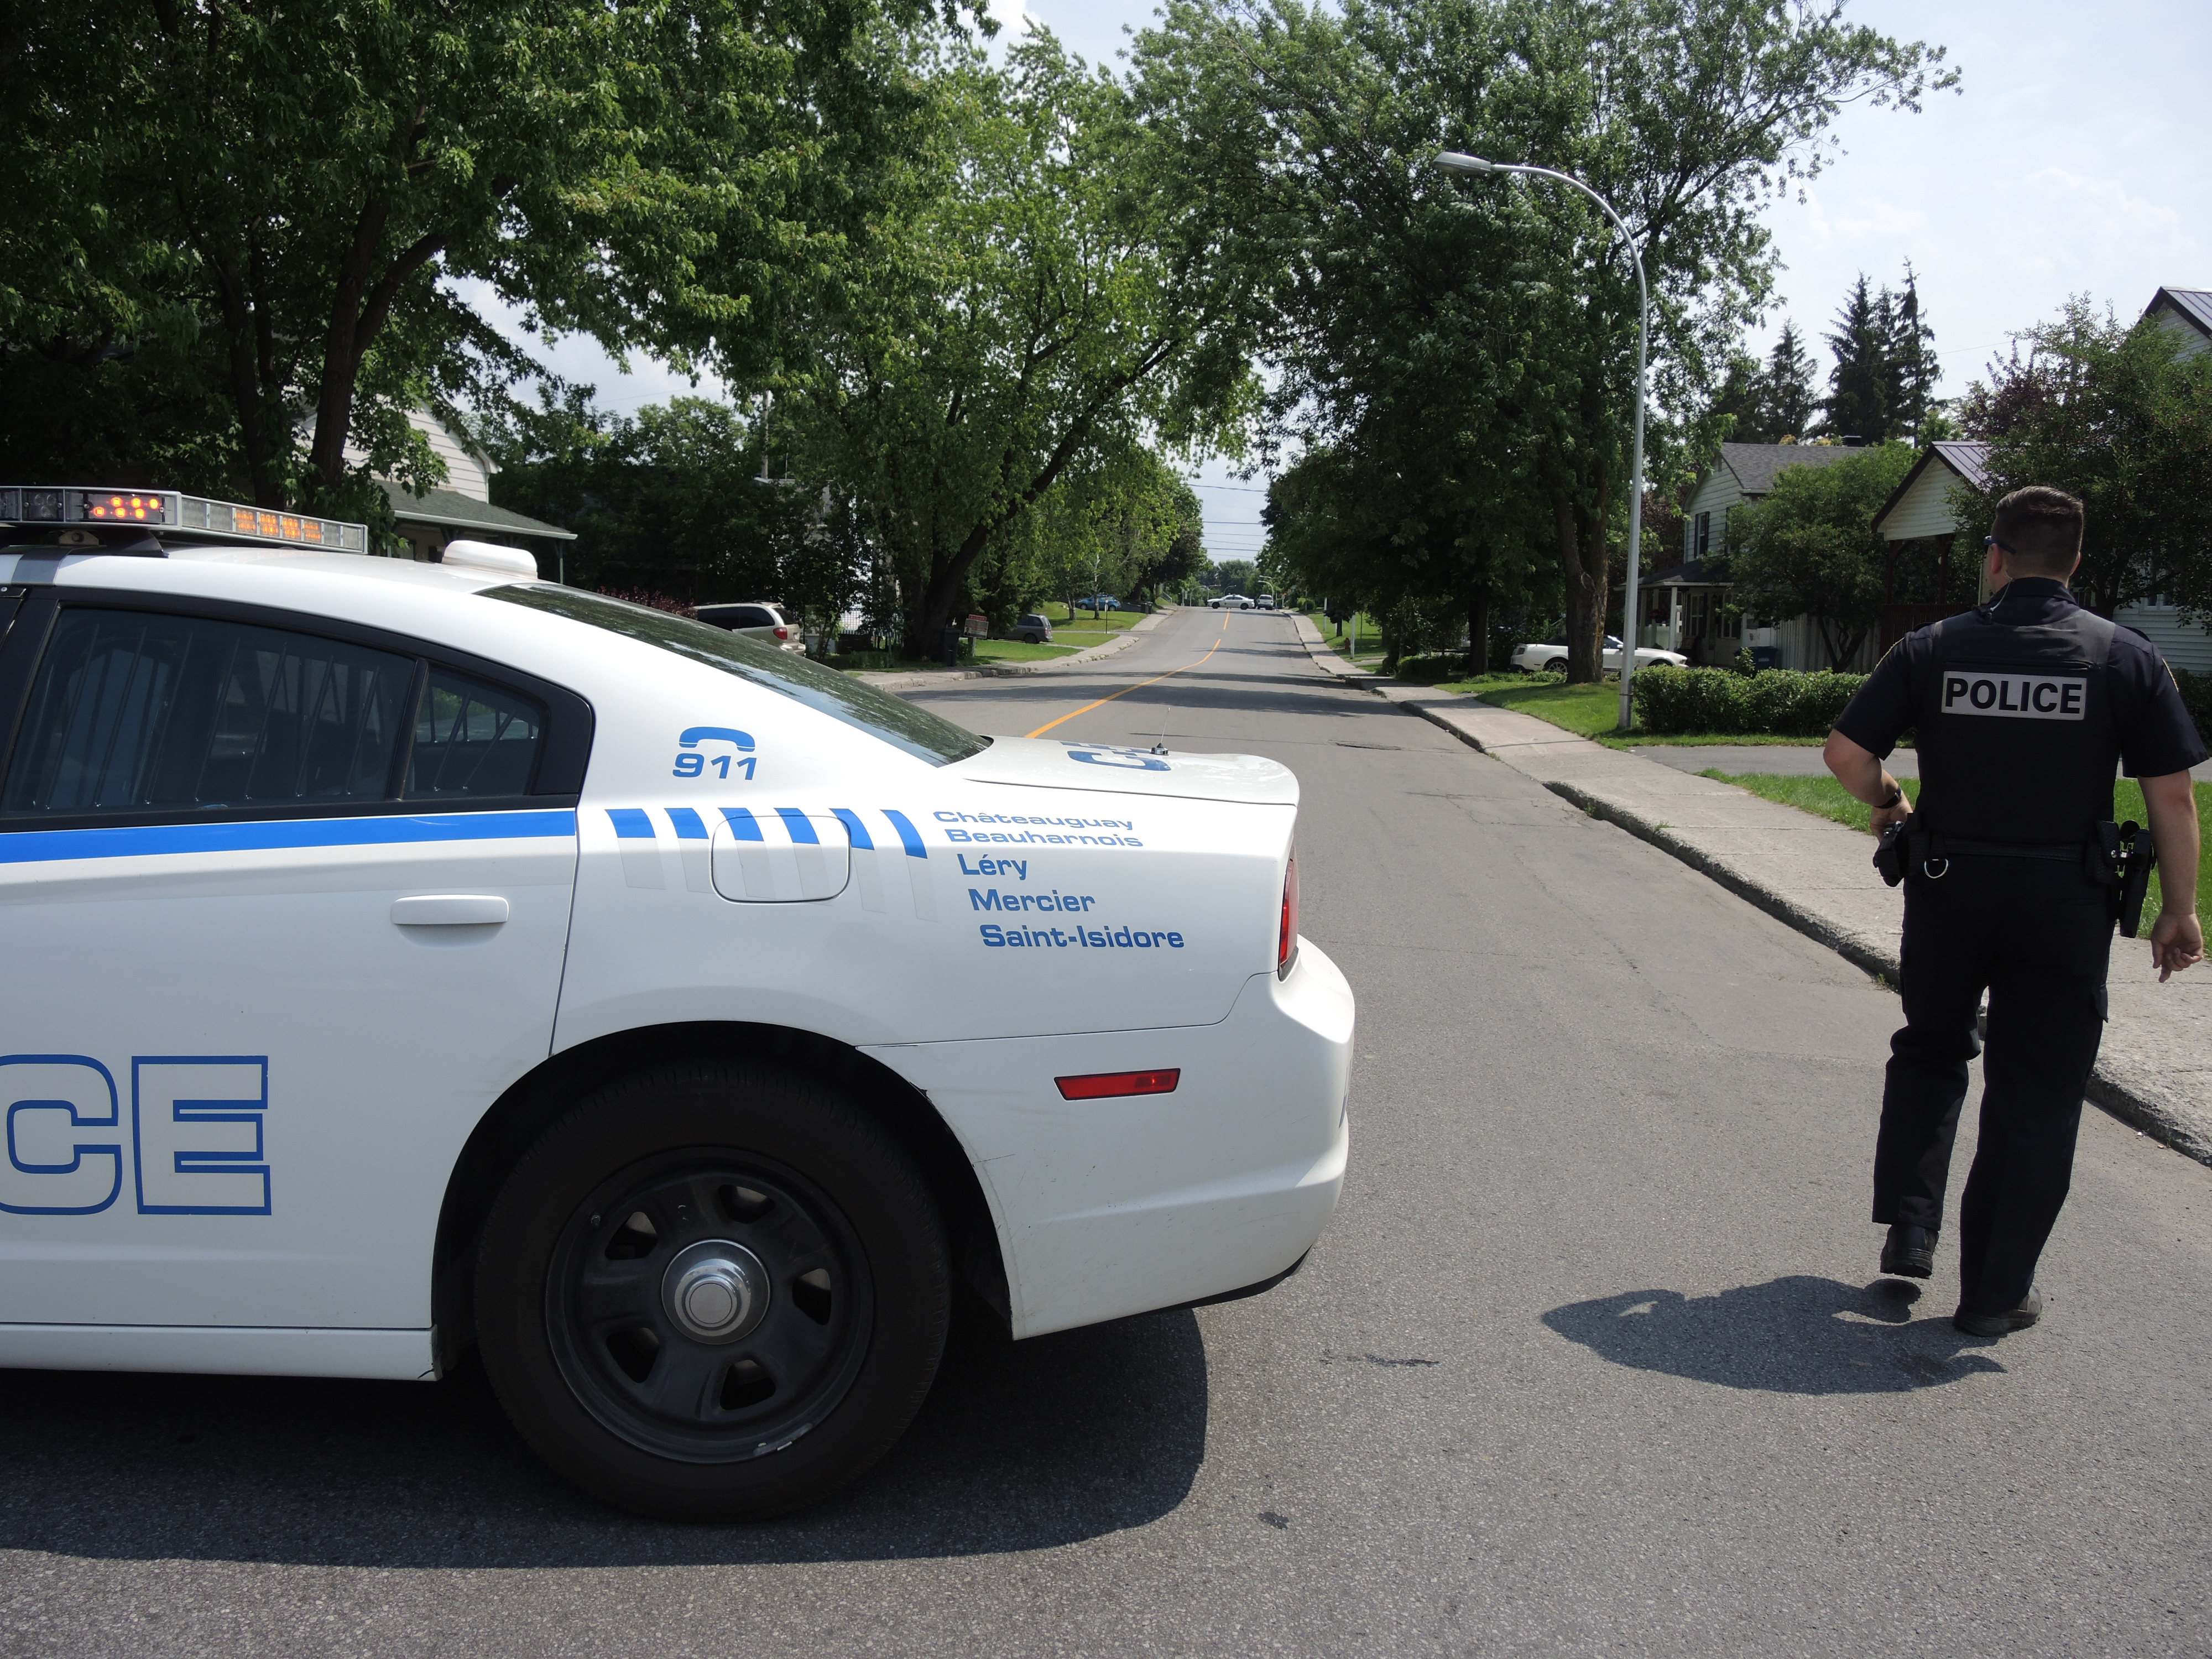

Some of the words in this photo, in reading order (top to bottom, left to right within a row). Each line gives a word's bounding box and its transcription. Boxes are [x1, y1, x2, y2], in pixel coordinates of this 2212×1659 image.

[1945, 677, 2082, 714] POLICE
[672, 753, 757, 780] 911
[933, 811, 1134, 831] Châteauguay
[945, 830, 1144, 847] Beauharnois
[957, 853, 1027, 881] Léry
[968, 888, 1096, 912] Mercier
[979, 924, 1185, 948] Saint-Isidore
